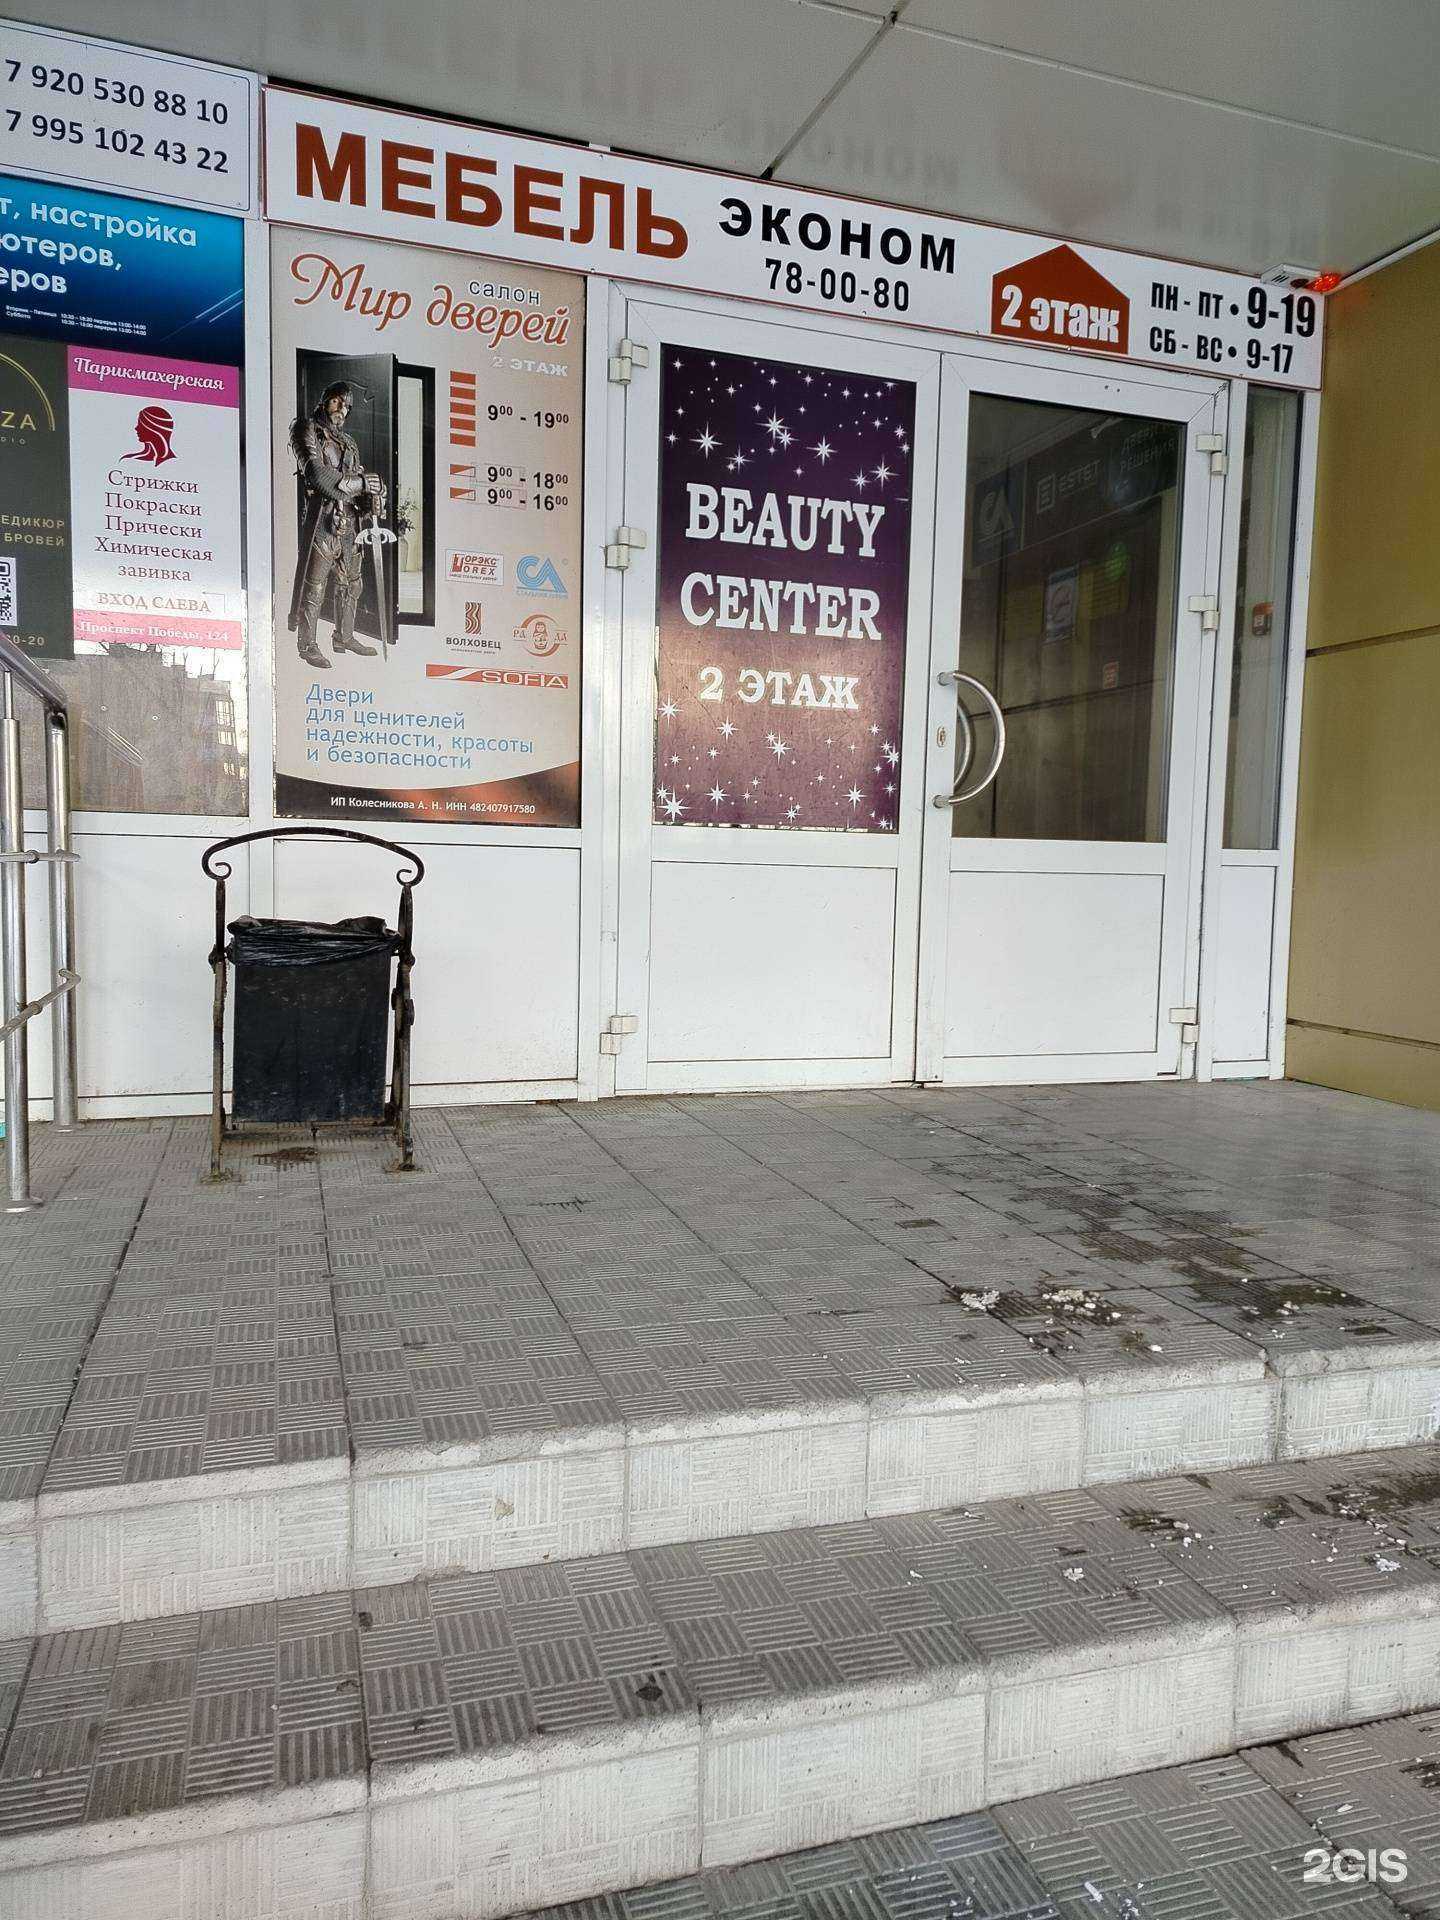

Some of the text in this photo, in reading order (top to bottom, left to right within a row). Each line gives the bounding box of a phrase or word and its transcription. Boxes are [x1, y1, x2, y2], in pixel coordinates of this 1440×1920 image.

[5, 59, 228, 125] 7 920 530 88 10
[5, 109, 229, 173] 7 995 102 43 22
[295, 122, 689, 260] МЕБЕЛЬ
[31, 202, 197, 247] настройка
[718, 197, 957, 275] ЭКОНОМ
[469, 278, 541, 306] салон
[764, 258, 910, 312] 78-00-80
[289, 252, 571, 349] Мир дверей
[1001, 284, 1121, 344] 2 этаж
[1151, 281, 1179, 312] ПН
[1199, 290, 1224, 319] ПТ
[1246, 286, 1316, 338] 9-19
[1150, 326, 1176, 354] СБ
[1196, 334, 1223, 363] ВС
[1246, 339, 1293, 374] 9-17
[74, 357, 225, 391] Парикмахерская
[491, 356, 568, 377] 2 ЭТАЖ
[108, 470, 200, 494] Стрижки
[105, 491, 202, 516] Покраски
[105, 514, 203, 539] Прически
[685, 482, 886, 558] BEAUTY
[4, 532, 65, 548] БРОВЕЙ
[94, 536, 213, 562] Химическая
[118, 565, 192, 582] завивка
[97, 592, 212, 613] ВХОД СЛЕВА
[679, 571, 882, 641] CENTER
[79, 621, 230, 643] Проспект Победы, 124
[446, 637, 502, 650] ВОЛХОВЕЦ
[481, 669, 567, 689] SOFIA
[699, 666, 860, 710] 2 ЭТАЖ
[305, 683, 374, 707] Двери
[305, 707, 466, 731] для ценителей
[306, 728, 533, 755] надежности, красоты
[306, 746, 472, 770] и безопасности
[330, 796, 537, 815] ИП Колесникова А. Н. ИНН 482407917580
